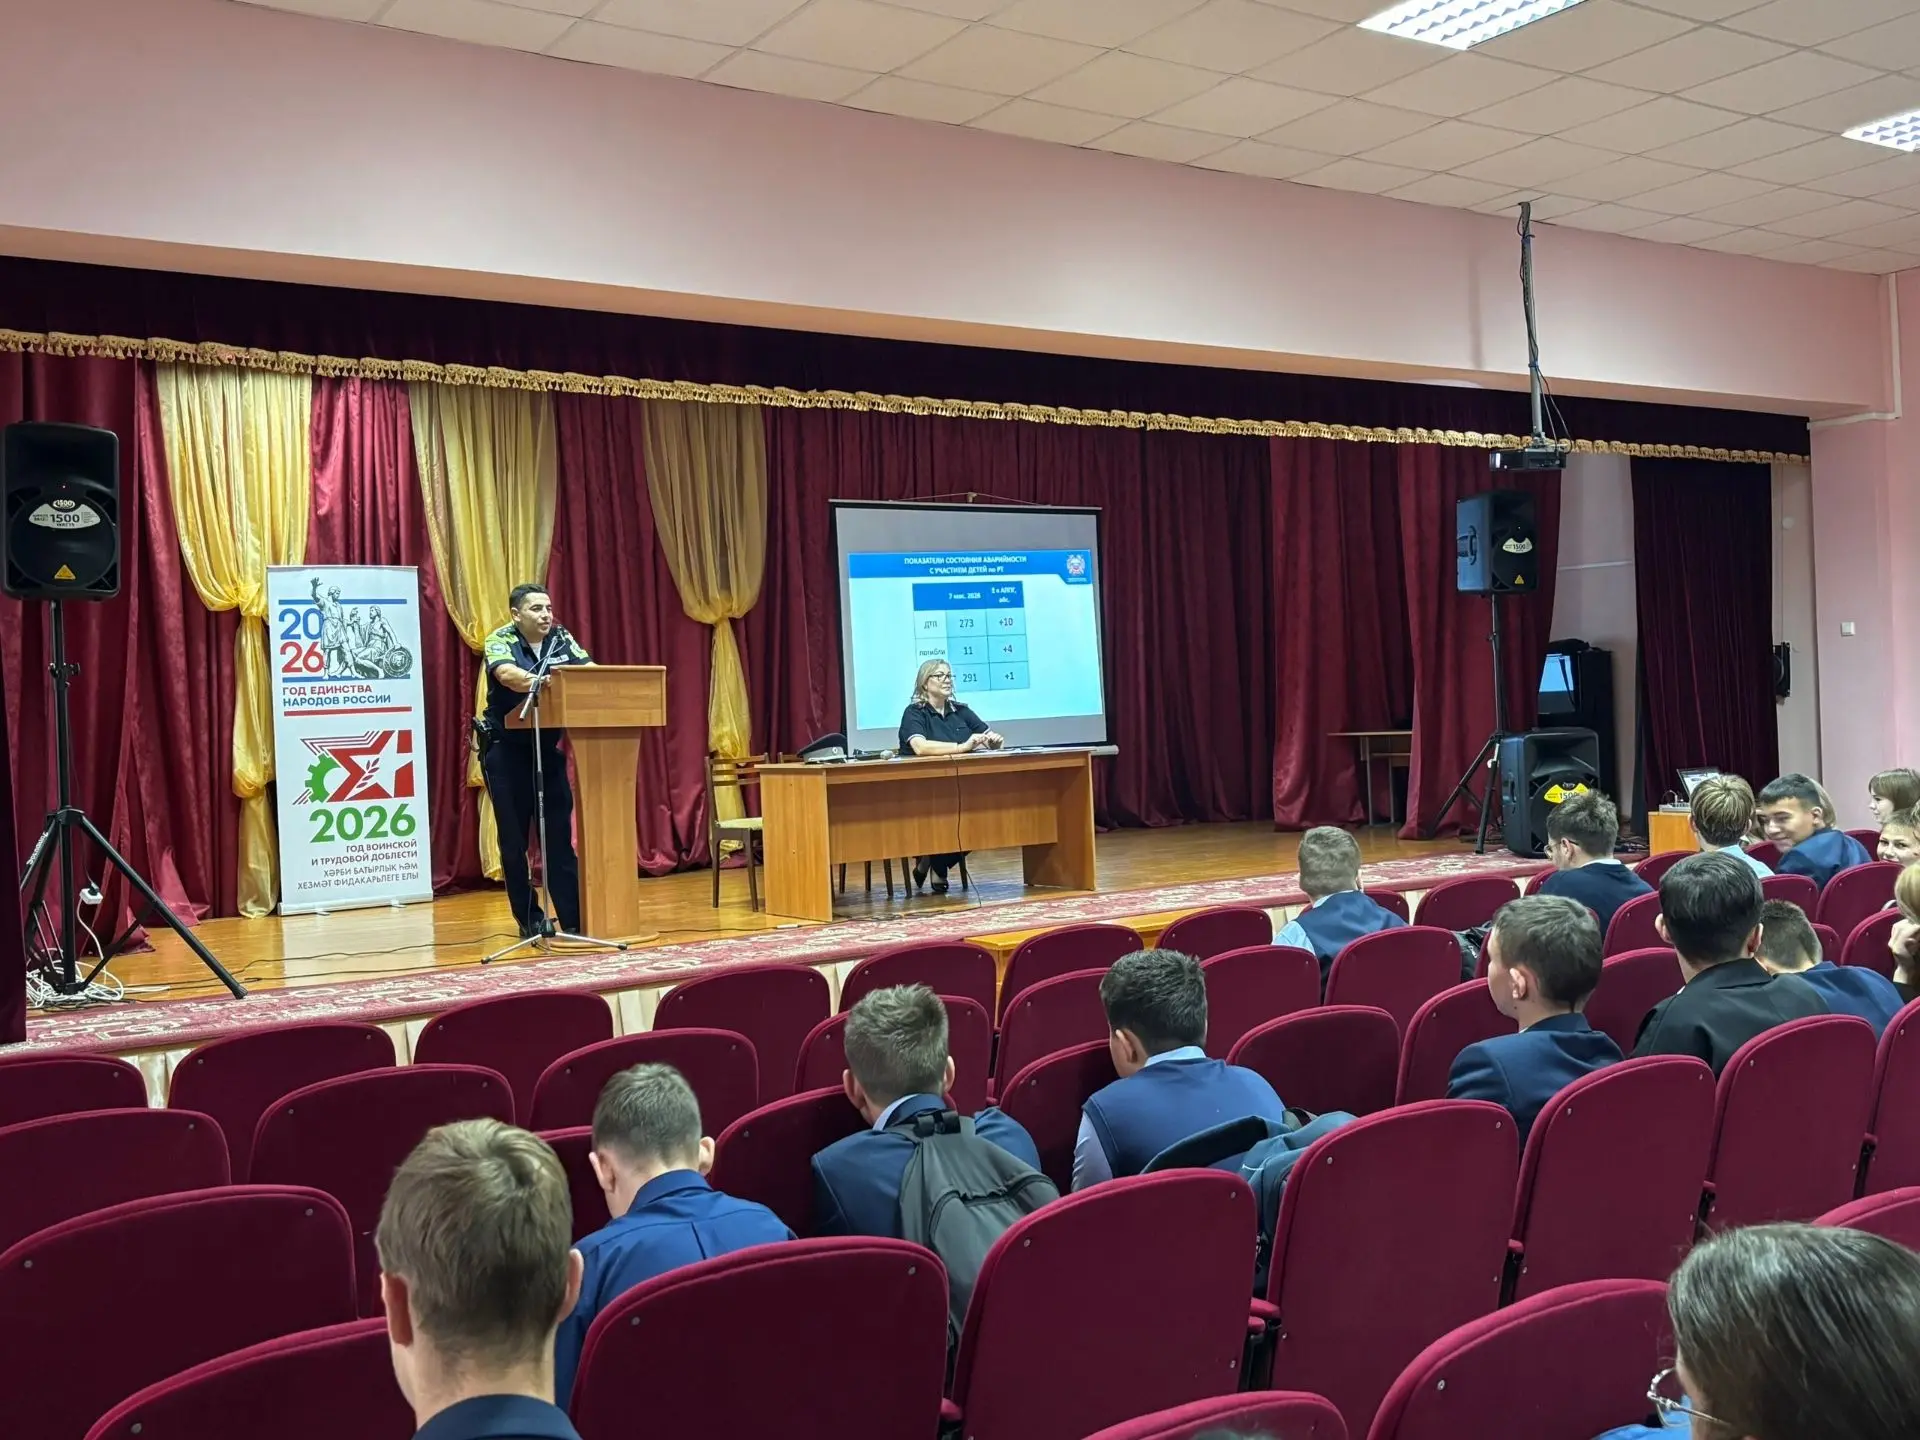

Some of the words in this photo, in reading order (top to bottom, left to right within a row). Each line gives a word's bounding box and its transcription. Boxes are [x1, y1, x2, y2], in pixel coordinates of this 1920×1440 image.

[50, 513, 80, 523] 1500
[904, 557, 944, 565] ПОКАЗАТЕЛИ
[945, 556, 982, 564] СОСТОЯНИЯ
[983, 555, 1027, 563] АВАРИЙНОСТИ
[968, 565, 987, 574] ДЕТЕЙ
[279, 608, 324, 640] 20
[924, 620, 938, 629] ДТП
[959, 619, 974, 628] 273
[999, 617, 1014, 626] +10
[963, 646, 973, 655] 11
[1003, 645, 1013, 653] +4
[280, 641, 324, 673] 26
[963, 673, 978, 682] 291
[1005, 672, 1015, 680] +1
[283, 686, 307, 696] ГОД
[311, 684, 373, 695] ЕДИНСТВА
[283, 696, 340, 707] НАРОДОВ
[343, 694, 391, 705] РОССИИ
[309, 803, 416, 843] 2026
[346, 844, 364, 853] ГОД
[366, 839, 417, 851] ВОИНСКОЙ
[311, 858, 319, 866] И
[321, 852, 369, 865] ТРУДОВОЙ
[371, 851, 418, 862] ДОБЛЕСТИ
[323, 866, 352, 878] ХӘРБИ
[353, 863, 396, 875] БАТЫРЛЫК
[297, 879, 332, 890] ХЕЗМӘТ
[334, 873, 400, 887] ФИДАКАРЬЛЕГЕ
[401, 872, 419, 881] ЕЛЫ
